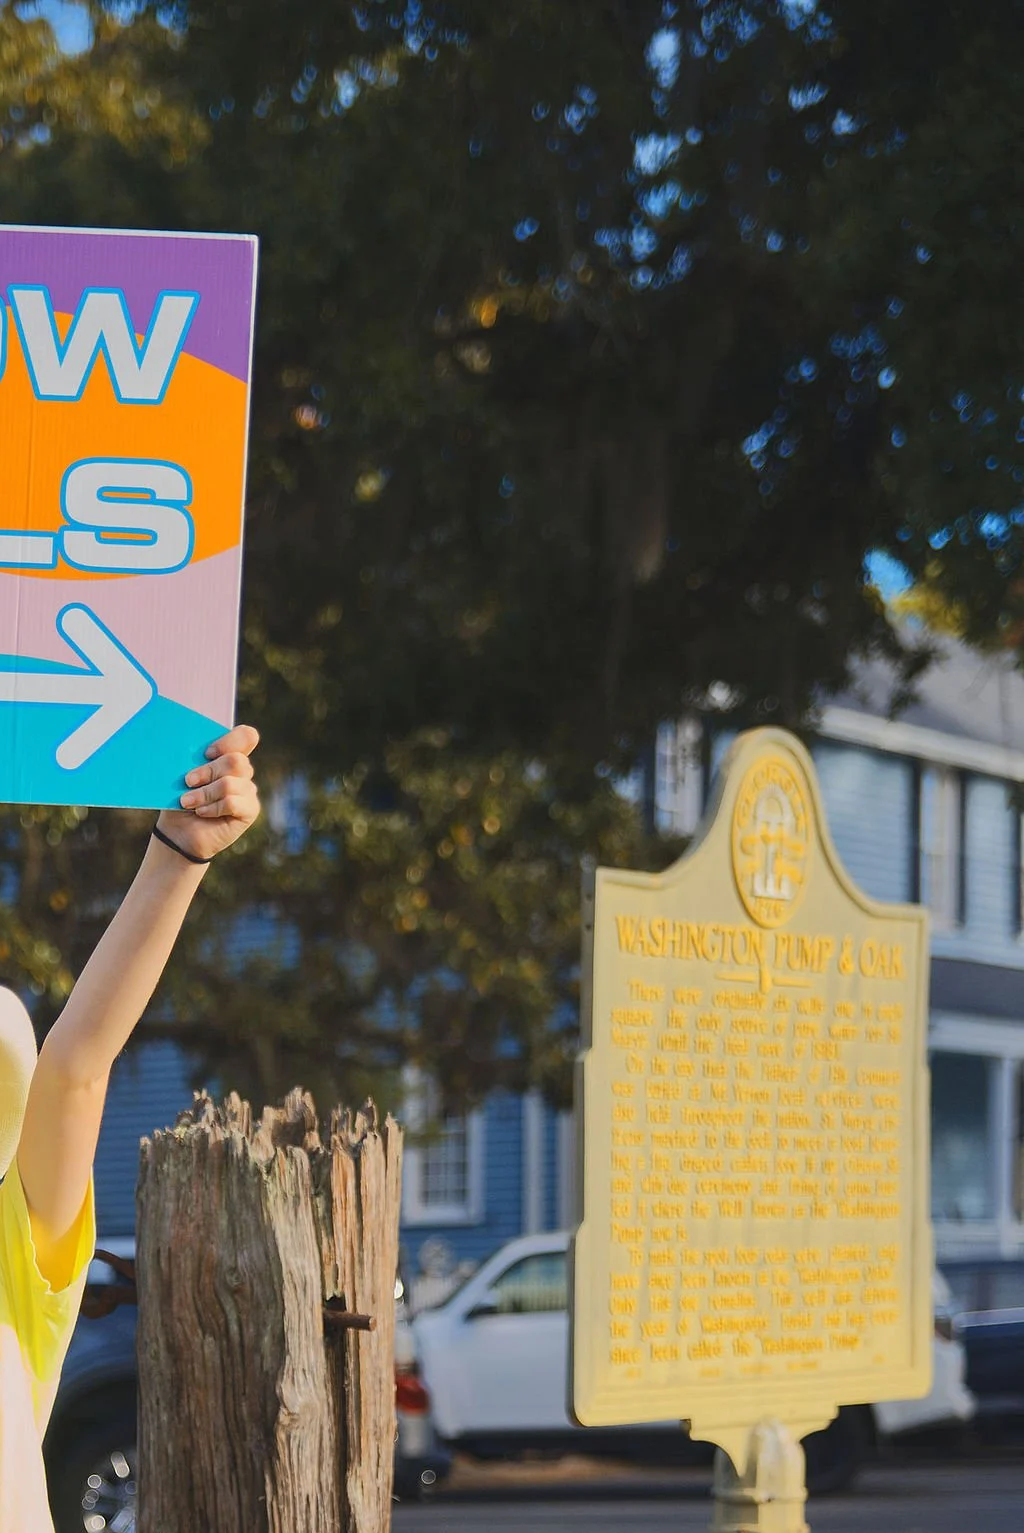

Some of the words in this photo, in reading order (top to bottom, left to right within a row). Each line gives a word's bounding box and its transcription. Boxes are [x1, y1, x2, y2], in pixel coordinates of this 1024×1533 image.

[616, 916, 763, 965] WASHINGTON
[774, 932, 835, 973] PUMP
[838, 934, 855, 975] &
[860, 938, 905, 980] OAK
